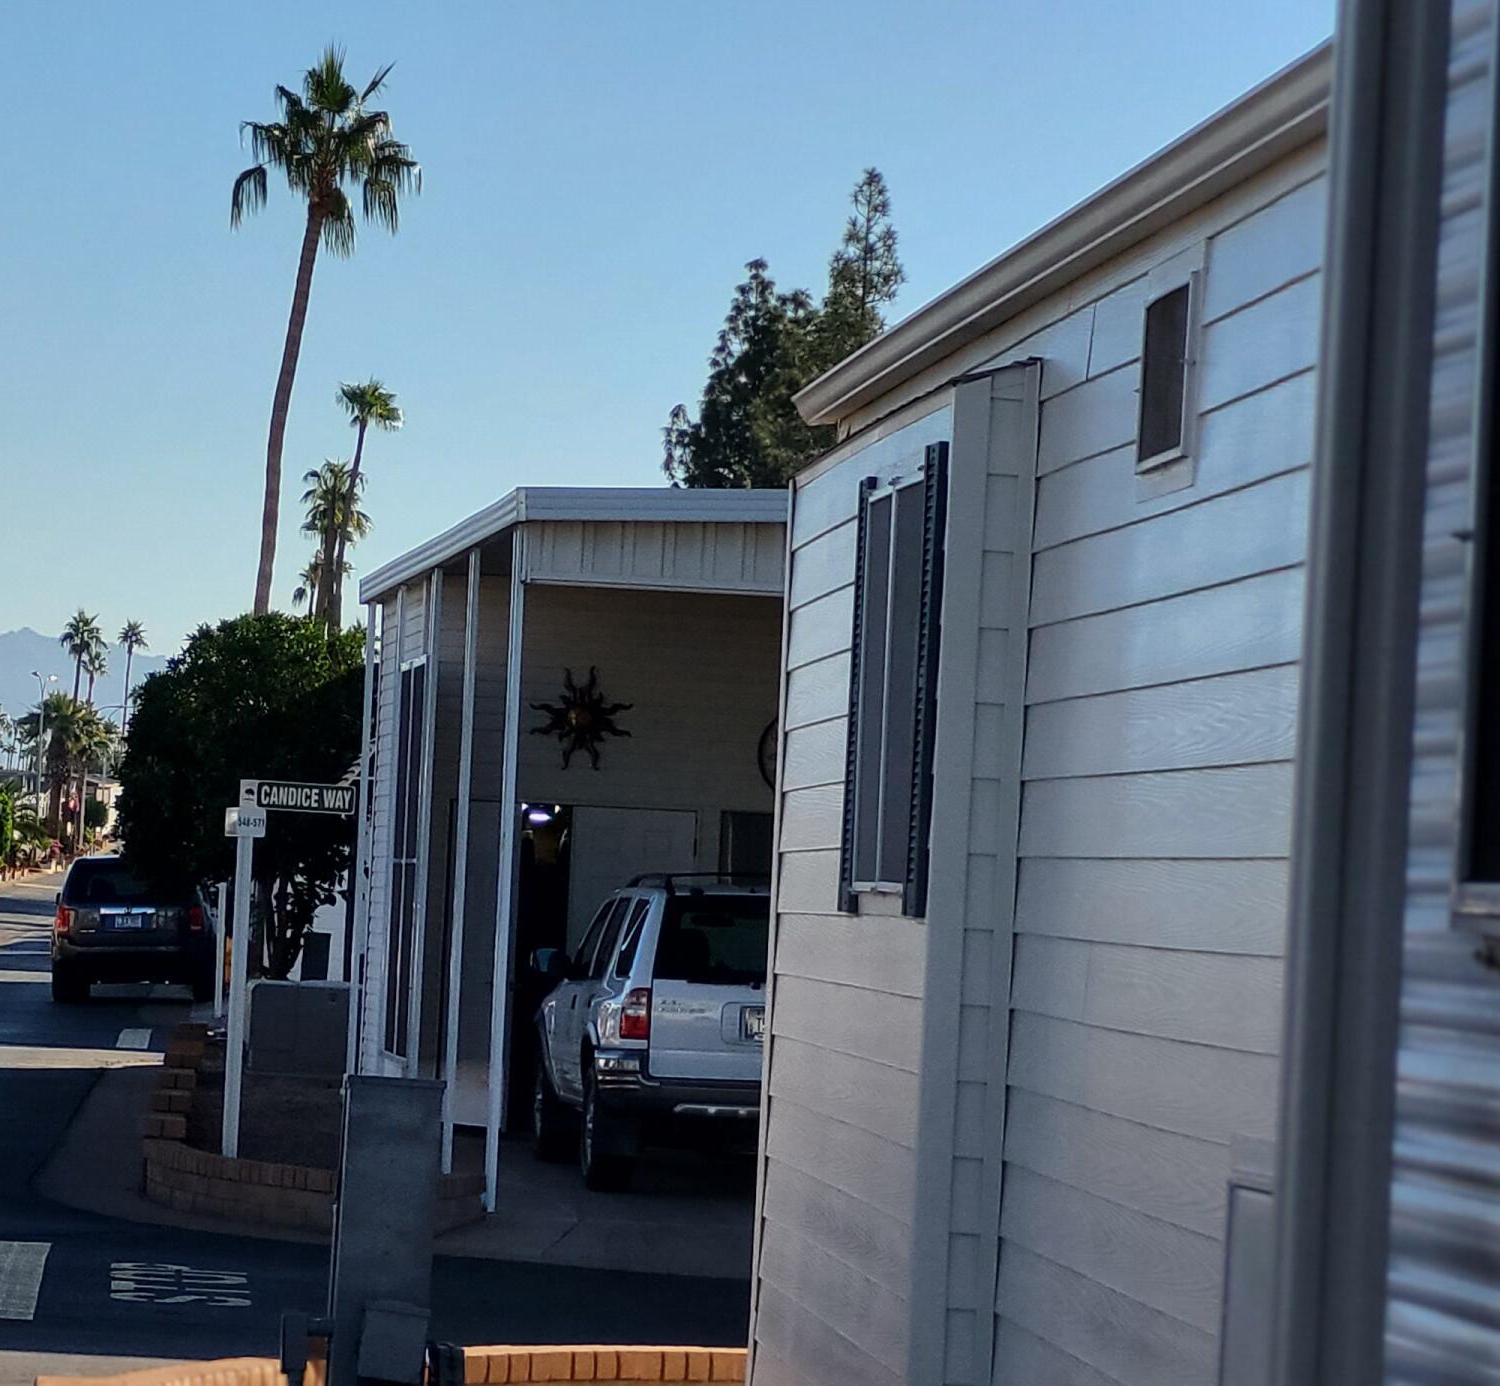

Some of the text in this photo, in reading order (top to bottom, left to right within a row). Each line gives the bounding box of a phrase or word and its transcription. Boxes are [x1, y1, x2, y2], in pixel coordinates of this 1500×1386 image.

[261, 785, 352, 810] CANDICE WAY
[109, 1262, 252, 1307] STOP
